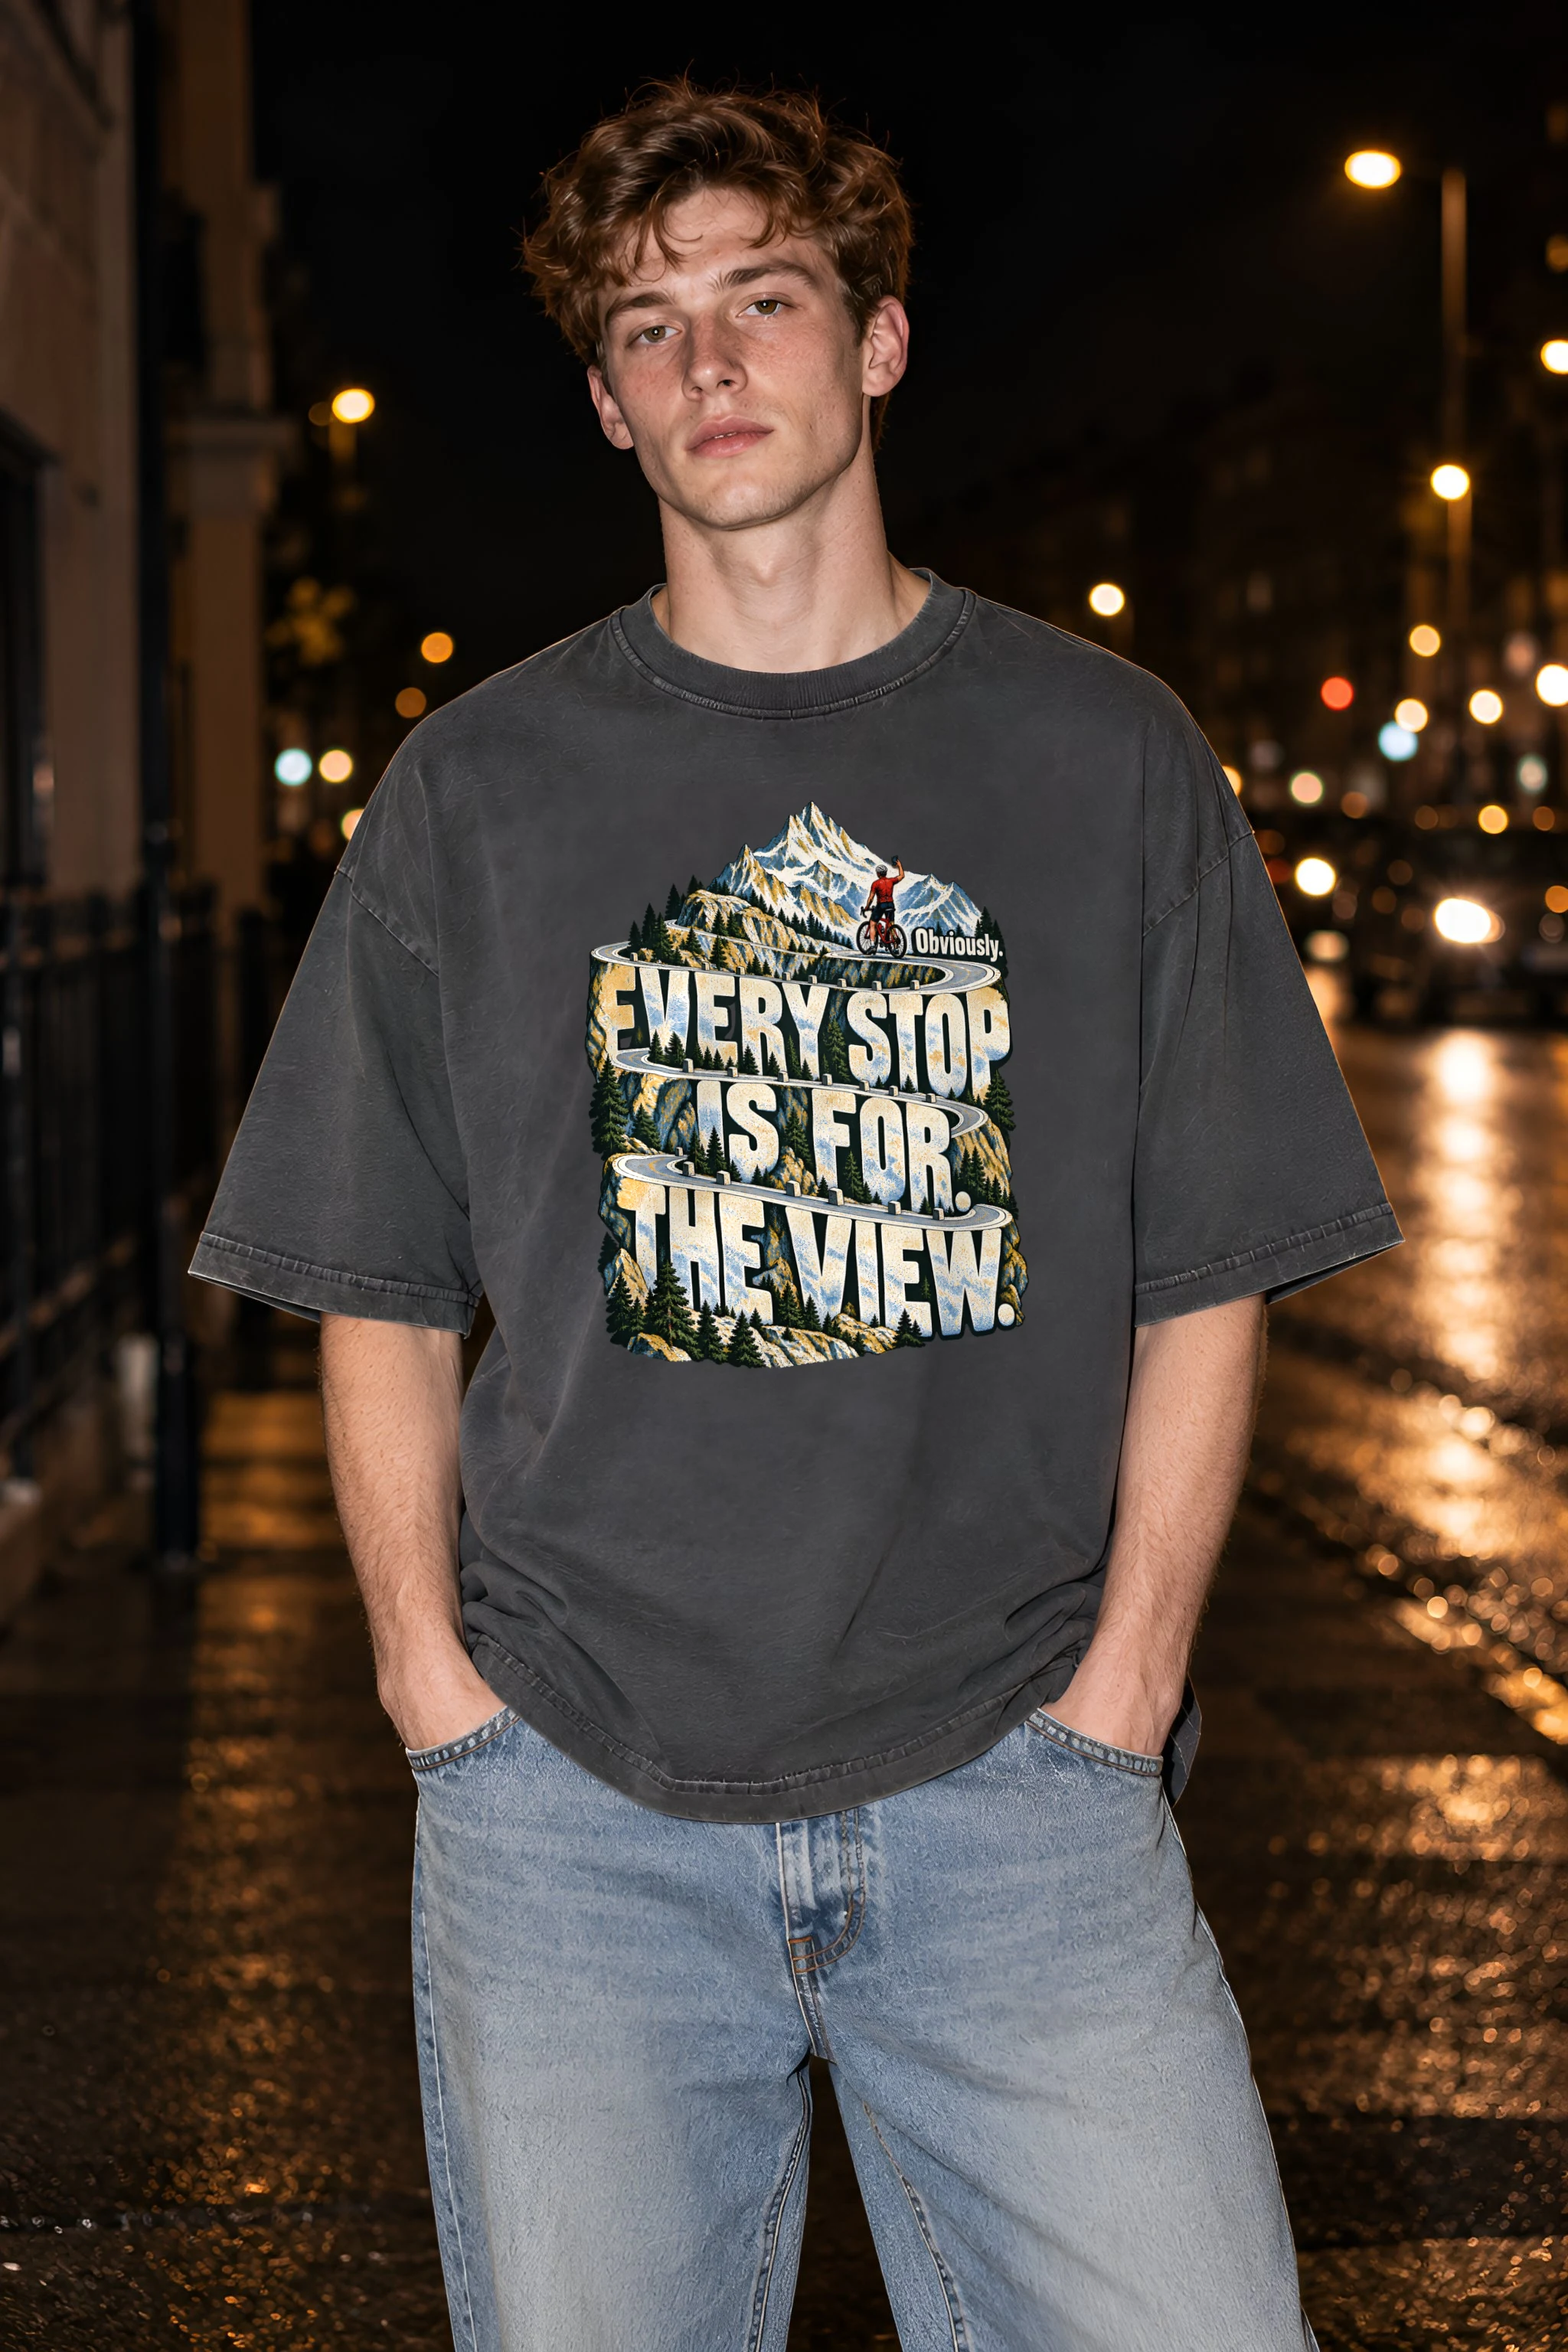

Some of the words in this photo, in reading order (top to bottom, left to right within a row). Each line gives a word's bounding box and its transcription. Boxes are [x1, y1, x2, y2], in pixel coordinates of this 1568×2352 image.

[915, 928, 1003, 962] Obviously.
[599, 963, 829, 1078] EVERY
[847, 985, 1010, 1098] STOP
[695, 1080, 779, 1183] IS
[812, 1089, 971, 1213] FOR.
[616, 1180, 773, 1325] THE
[786, 1207, 1014, 1338] VIEW.
